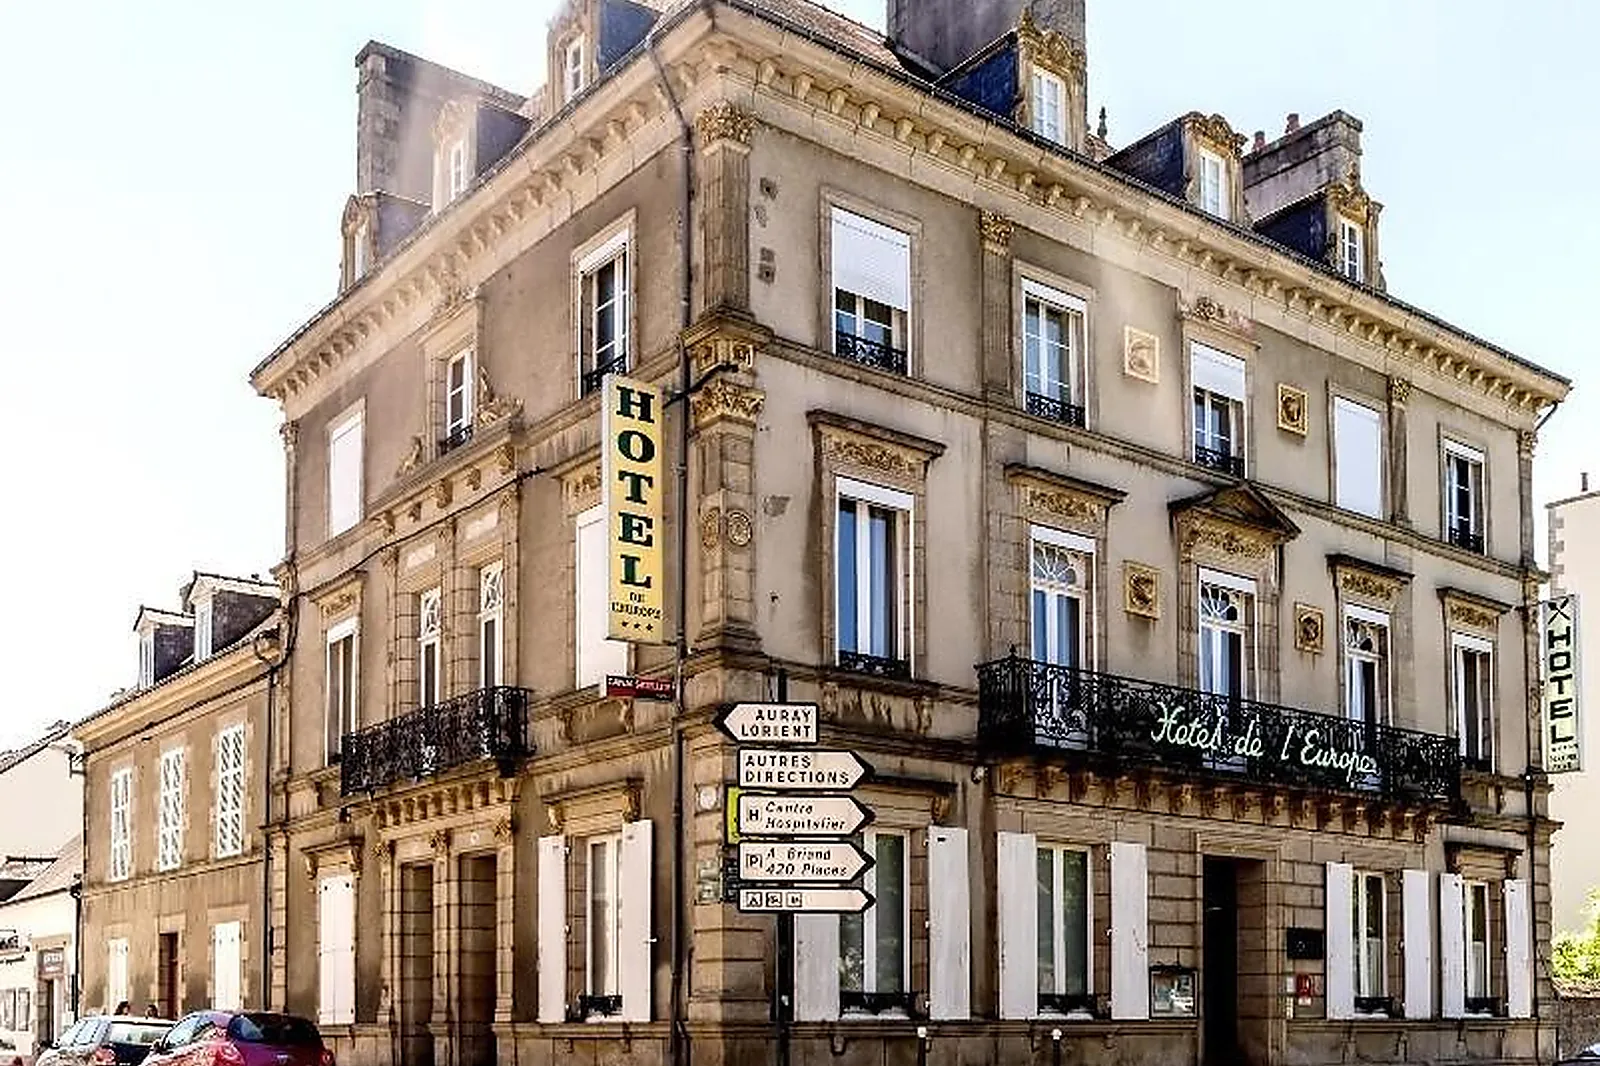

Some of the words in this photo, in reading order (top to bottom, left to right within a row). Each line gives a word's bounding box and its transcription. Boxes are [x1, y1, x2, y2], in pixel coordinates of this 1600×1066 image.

[616, 385, 655, 589] HOTEL
[1548, 626, 1574, 744] HOTEL
[755, 709, 811, 722] AURAY
[741, 724, 811, 737] LORIENT
[1234, 719, 1263, 756] de
[745, 755, 811, 768] AUTRES
[745, 771, 849, 785] DIRECTIONS
[765, 801, 813, 814] Centre
[765, 817, 846, 832] Hospitalier
[787, 847, 831, 860] Briand
[765, 863, 795, 875] 420
[801, 863, 847, 877] Places
